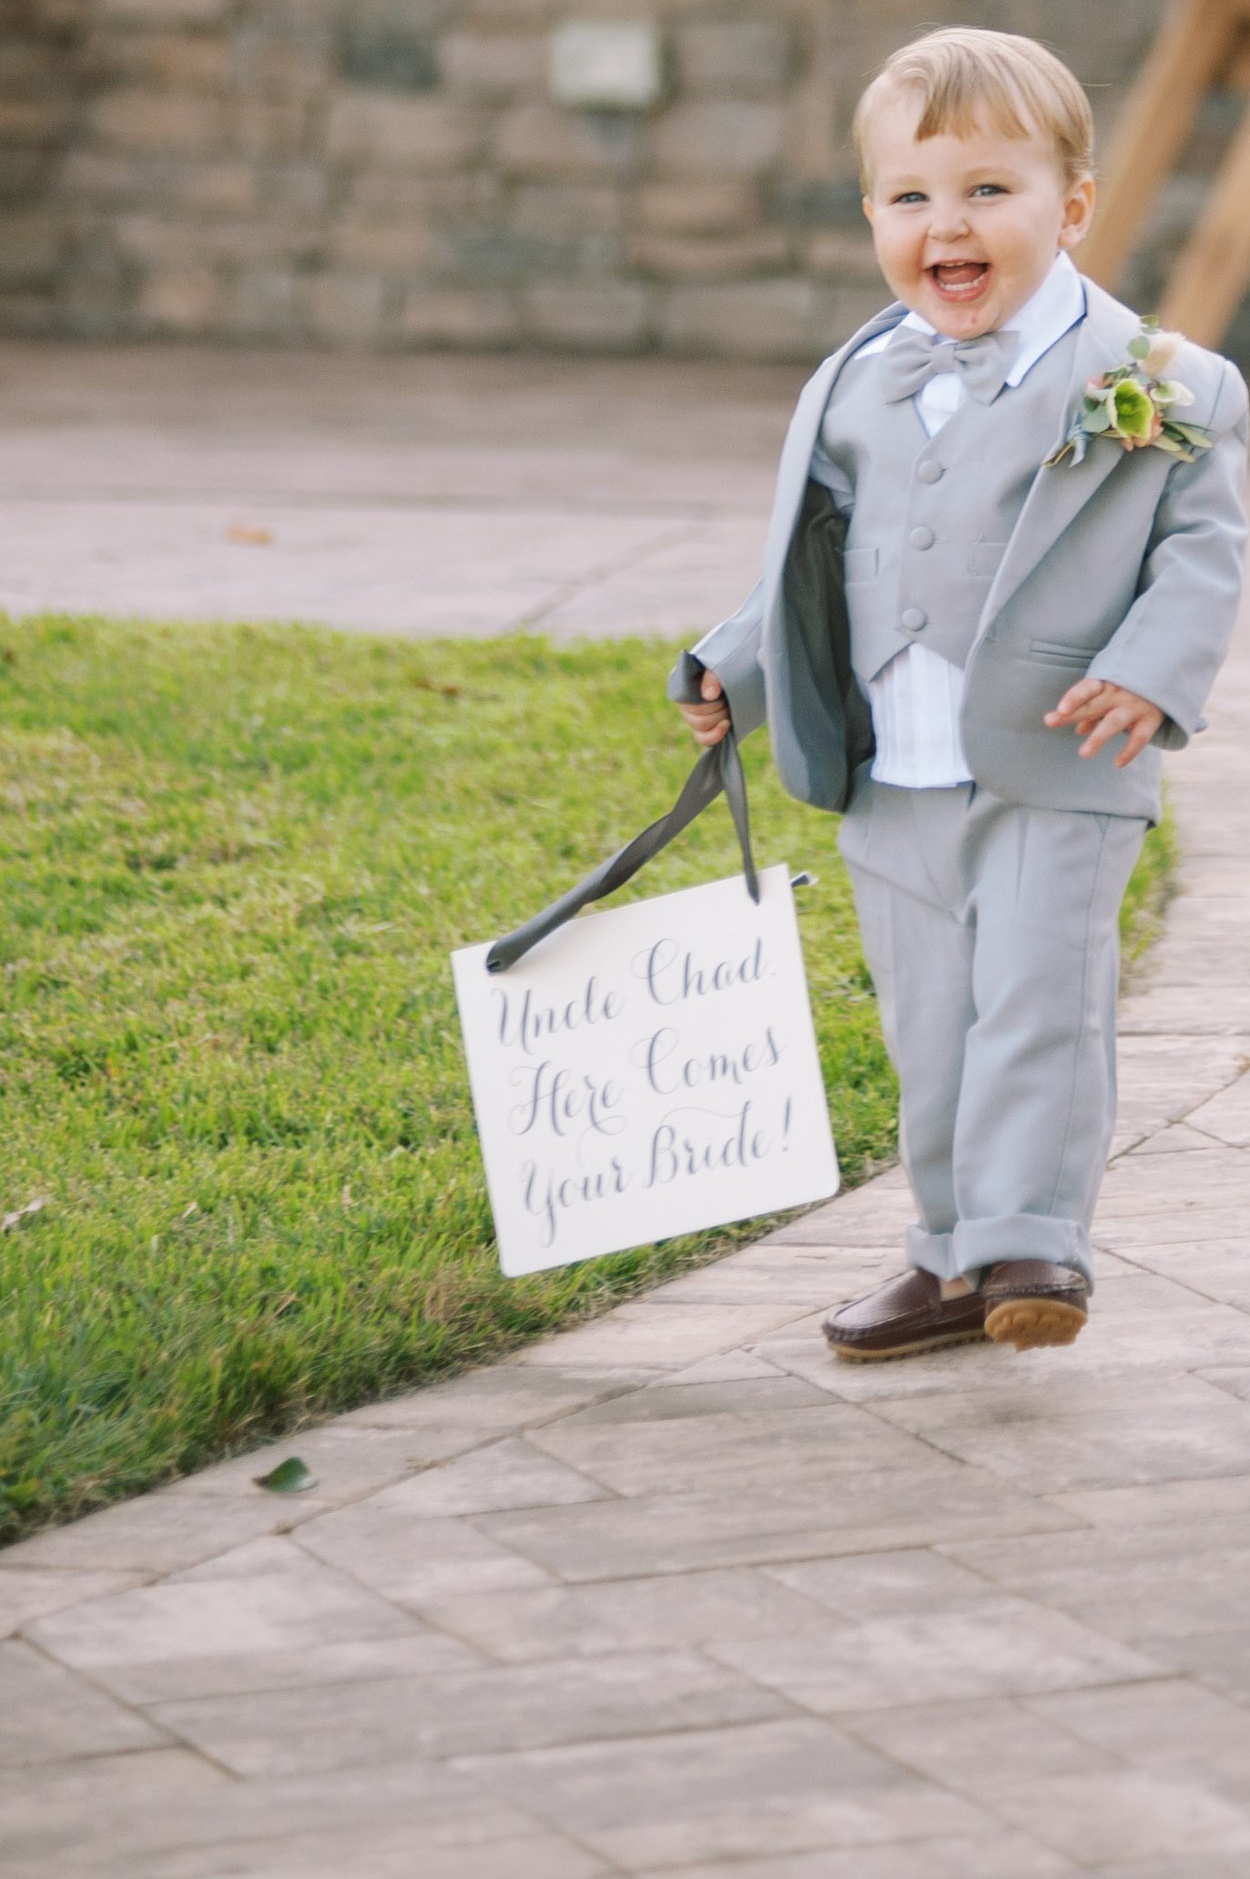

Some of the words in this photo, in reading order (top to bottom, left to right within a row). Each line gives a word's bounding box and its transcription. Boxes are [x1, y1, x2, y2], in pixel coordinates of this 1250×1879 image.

[490, 975, 626, 1055] Uncle
[507, 1059, 628, 1164] Here
[630, 1026, 787, 1096] Comes
[517, 1156, 632, 1249] Your
[644, 1096, 793, 1190] Bride!
